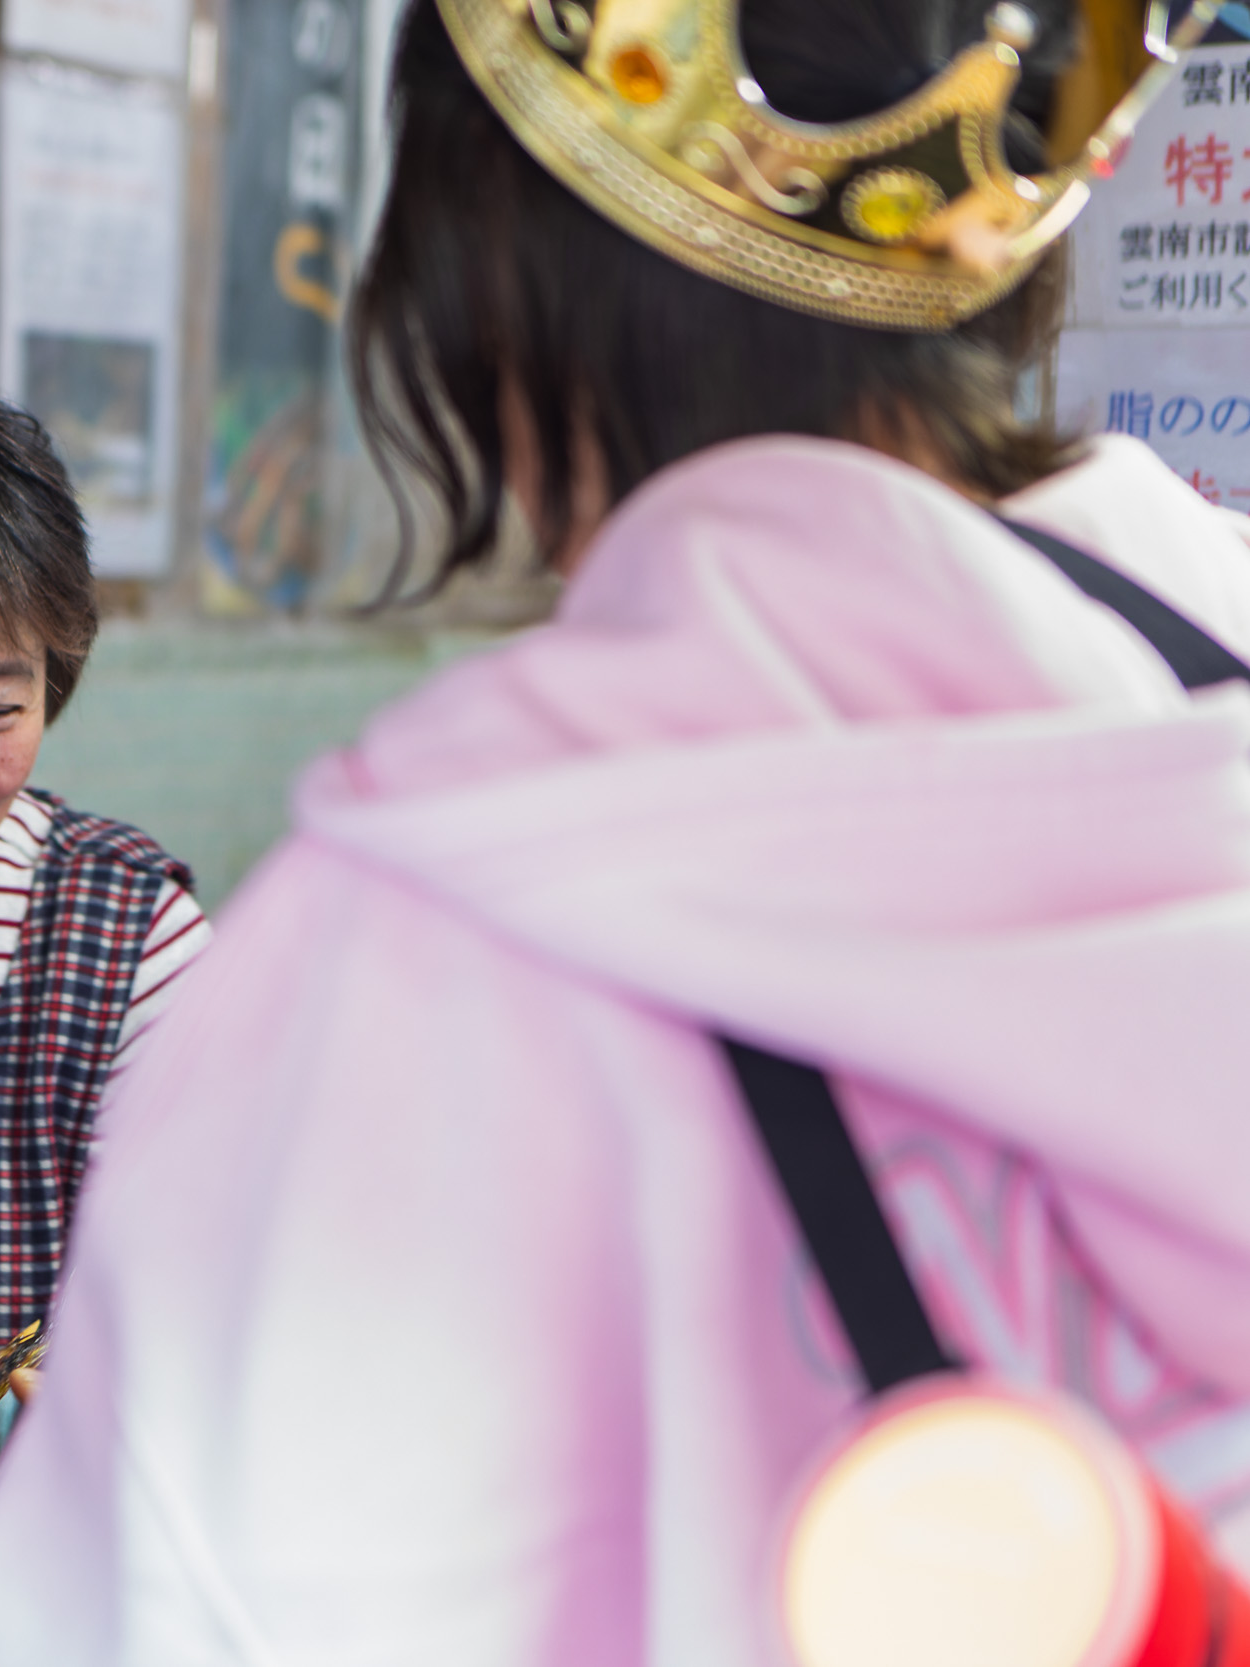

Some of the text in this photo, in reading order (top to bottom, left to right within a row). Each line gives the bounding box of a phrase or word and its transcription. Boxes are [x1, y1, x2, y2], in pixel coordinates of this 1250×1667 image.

[1164, 132, 1250, 208] 特
[1119, 270, 1247, 311] ご利用く
